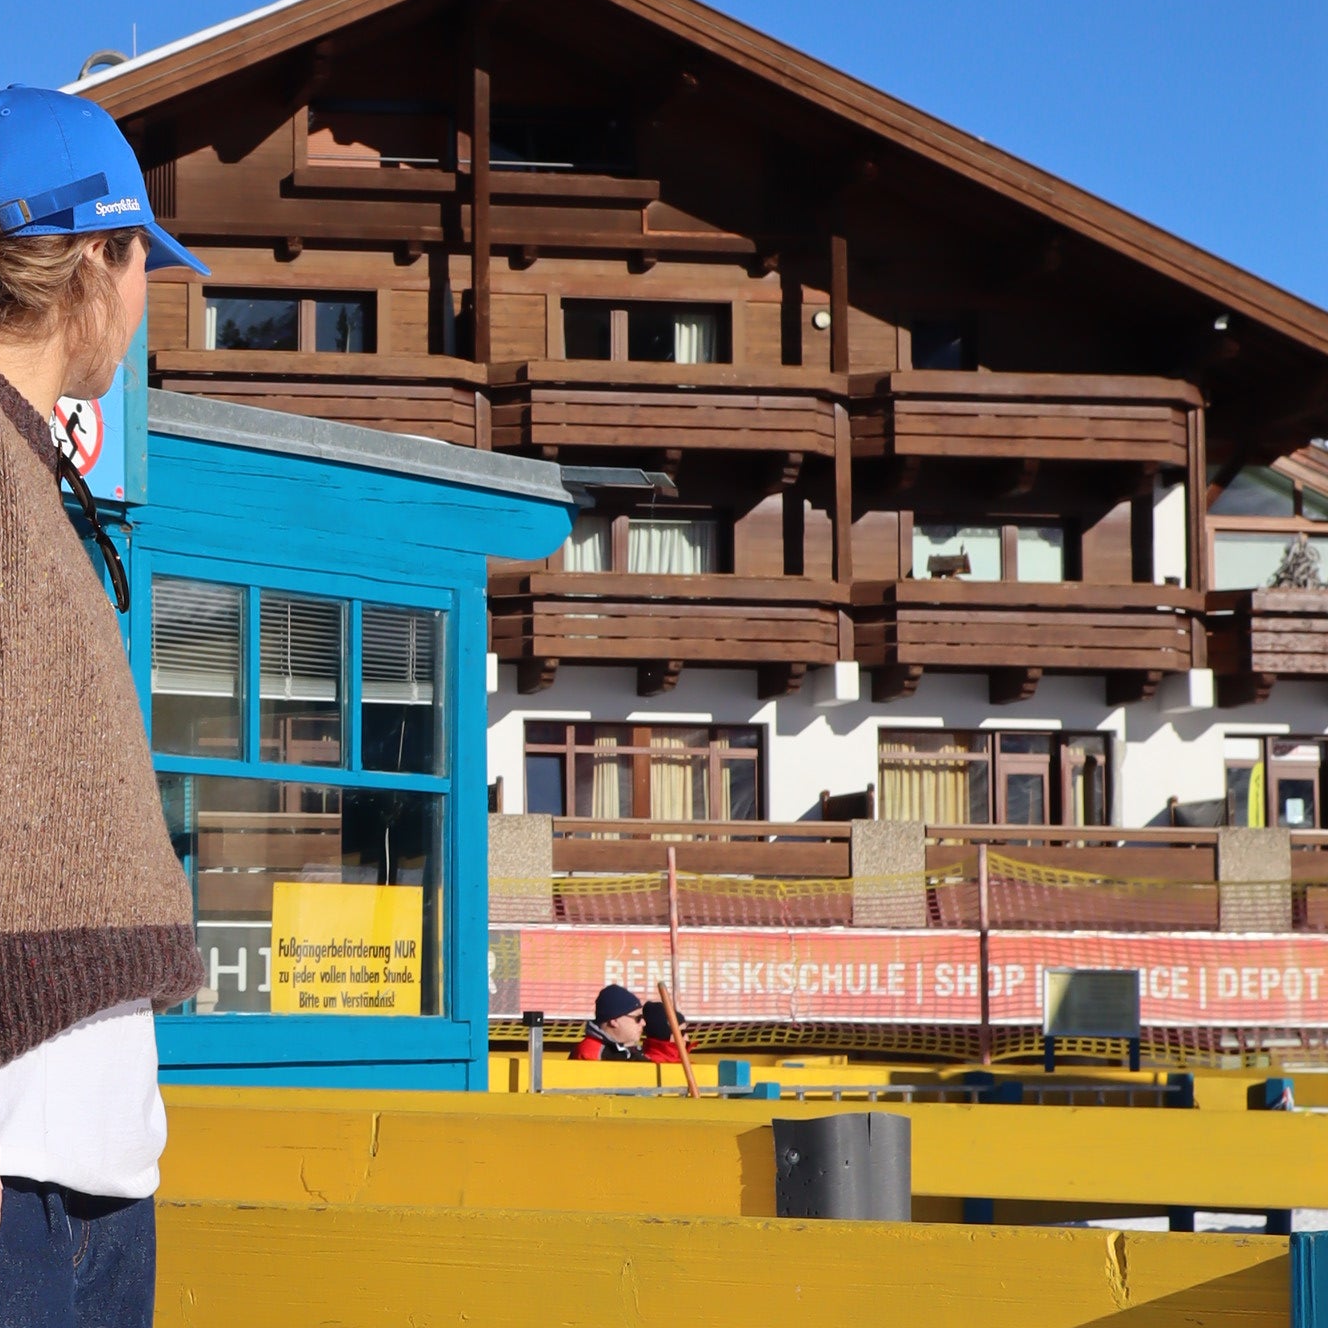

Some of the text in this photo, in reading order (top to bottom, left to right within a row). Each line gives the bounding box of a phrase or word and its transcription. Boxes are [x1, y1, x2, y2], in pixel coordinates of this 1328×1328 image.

[278, 937, 416, 963] Fußgängerbeförderung NUR
[279, 965, 414, 988] zu jeder vollen halben Stunde.
[604, 960, 693, 993] RENT
[720, 962, 905, 997] SKISCHULE
[934, 963, 1025, 998] SHOP
[1217, 967, 1325, 1000] DEPOT
[299, 990, 395, 1008] Bitte um Verständnis!
